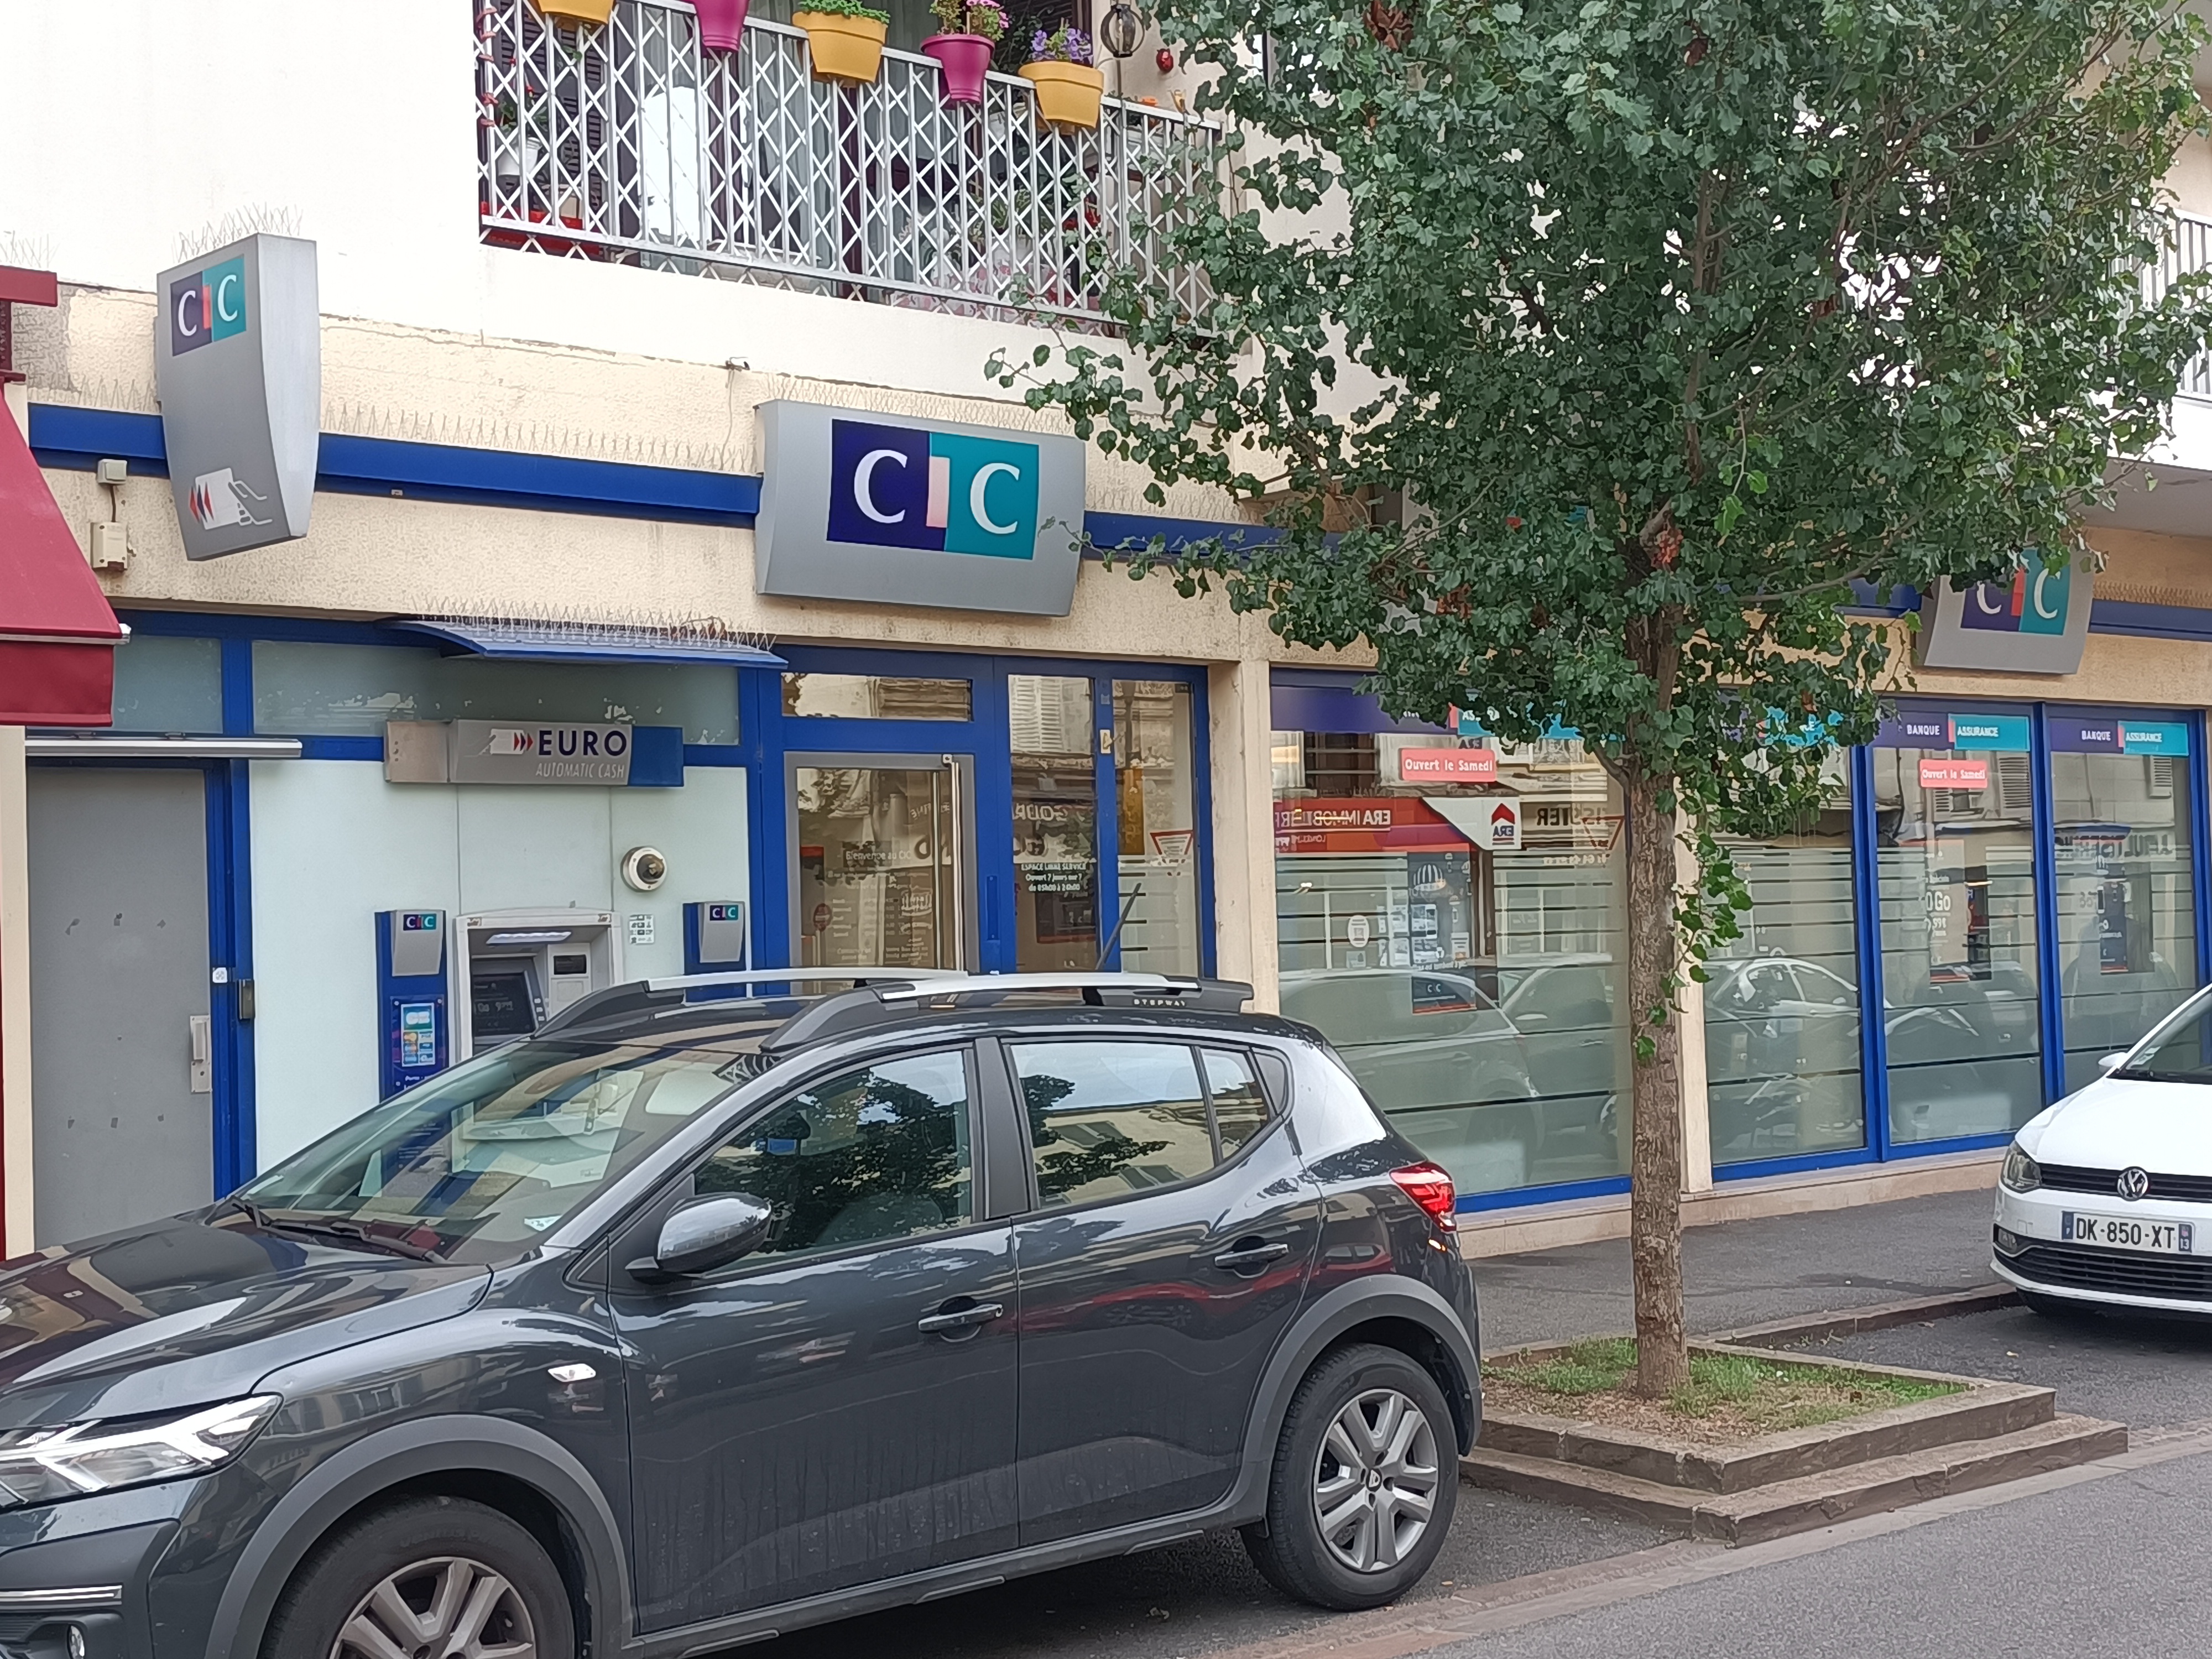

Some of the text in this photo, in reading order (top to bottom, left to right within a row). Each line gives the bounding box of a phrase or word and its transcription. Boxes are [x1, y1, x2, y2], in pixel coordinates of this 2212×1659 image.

[178, 274, 238, 336] CIC
[854, 450, 1020, 534] CIC
[1976, 568, 2058, 618] CIC
[1906, 724, 1999, 737] BANQUE ASSURANCE
[2081, 730, 2162, 743] BANQUE ASSURANCE
[538, 730, 627, 757] EURO
[535, 761, 625, 779] AUTOMATIC CASH
[1405, 759, 1493, 771] Ouvert le Samedi
[1921, 769, 1985, 780] Ouvert le Samedi
[712, 907, 736, 919] CIC
[406, 915, 434, 928] CIC
[2076, 1217, 2175, 1249] DK-850-XT
[2179, 1238, 2190, 1250] 13
